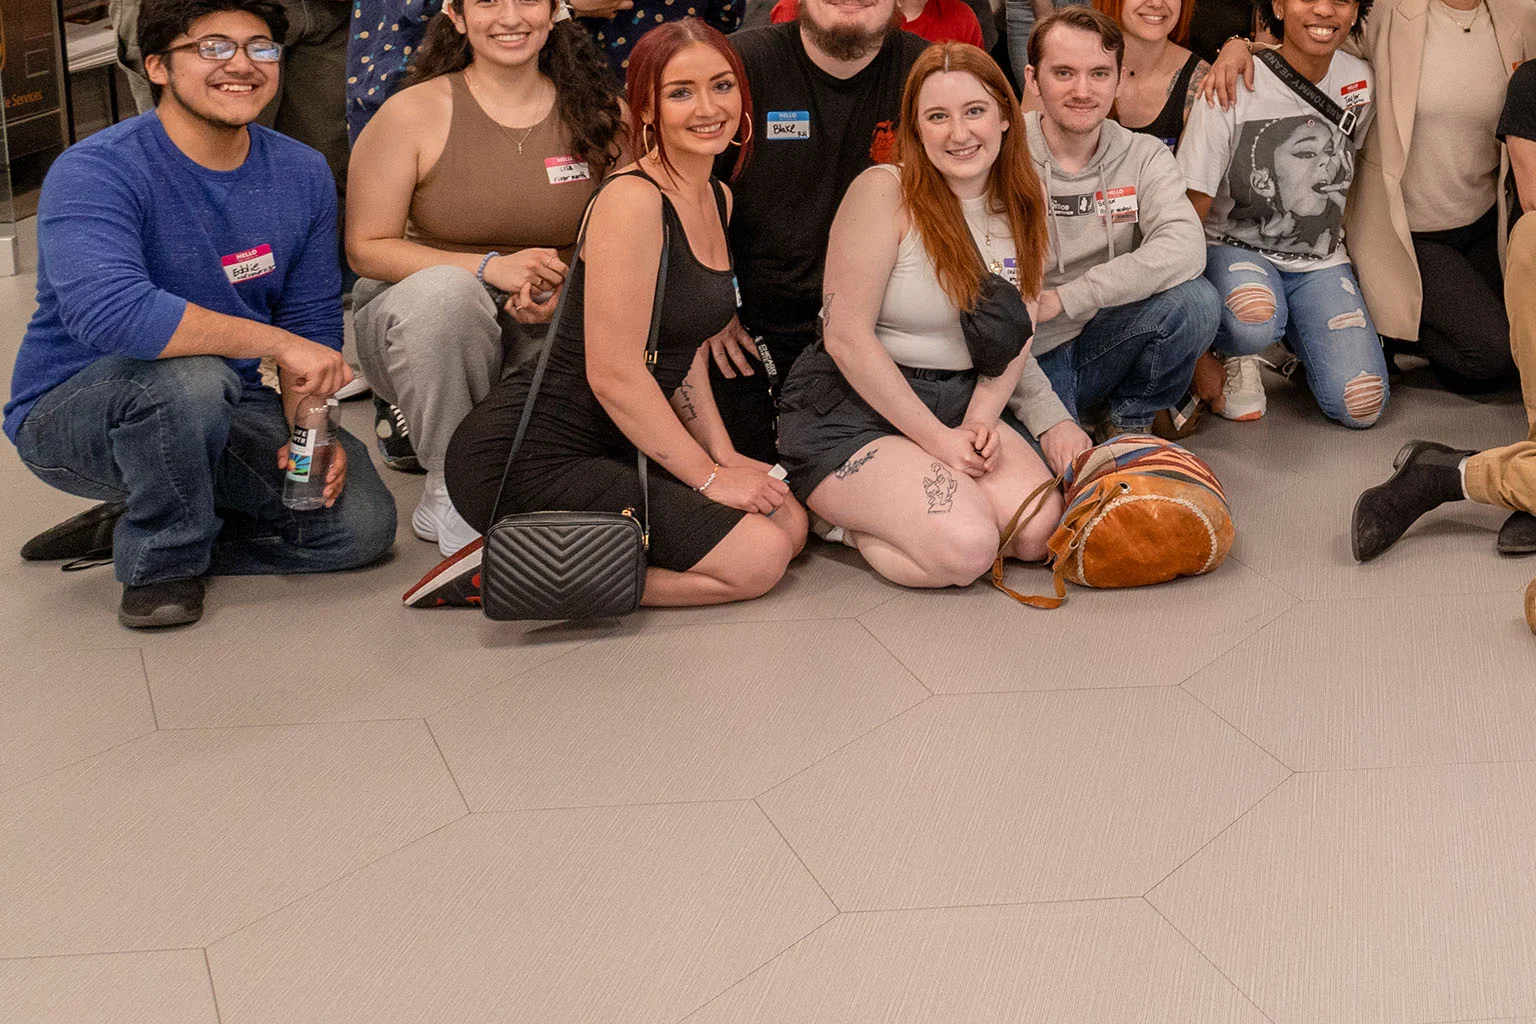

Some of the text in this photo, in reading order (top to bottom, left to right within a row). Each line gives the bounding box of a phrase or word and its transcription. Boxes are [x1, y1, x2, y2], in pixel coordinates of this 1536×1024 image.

[1292, 80, 1327, 107] TOMMY
[773, 124, 796, 135] Blake
[236, 249, 258, 260] HELLO
[232, 263, 260, 278] Eddie
